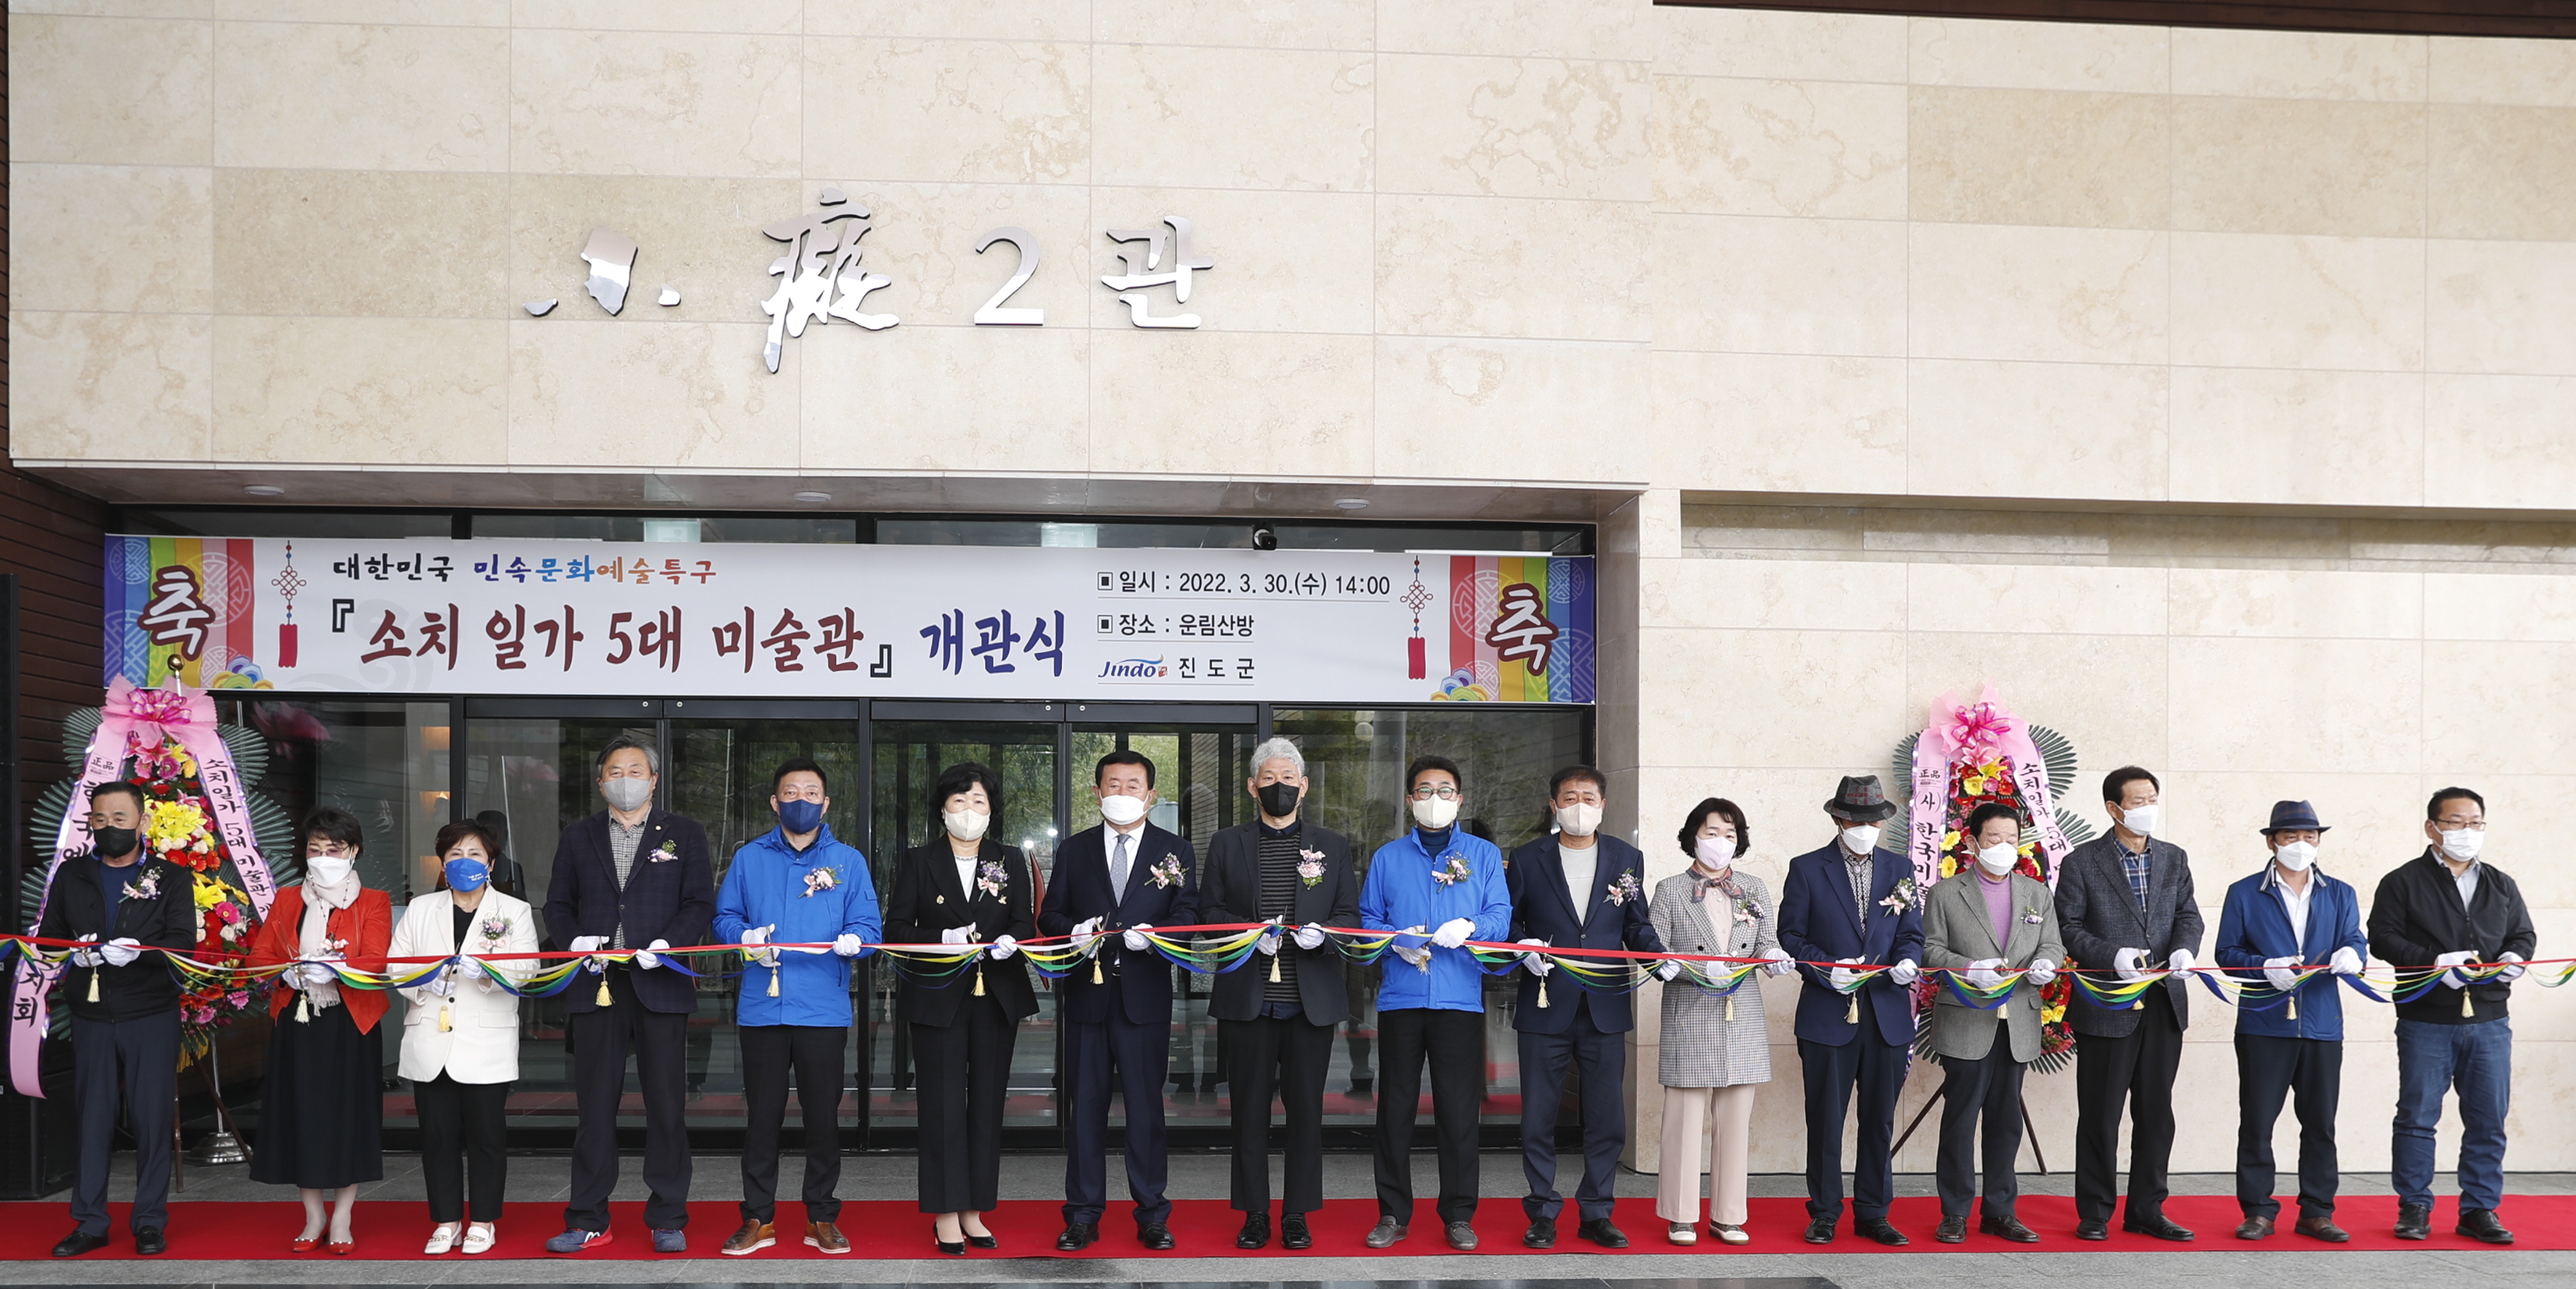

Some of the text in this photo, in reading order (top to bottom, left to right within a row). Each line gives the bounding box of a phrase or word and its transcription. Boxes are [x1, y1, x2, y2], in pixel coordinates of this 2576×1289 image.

[333, 553, 717, 584] 대한민국 민속문화예술특구
[1118, 570, 1156, 593] 일시
[1179, 573, 1233, 593] 2022.
[1240, 574, 1257, 593] 3.
[1264, 572, 1327, 596] 30.(수)
[1335, 575, 1391, 595] 14:00
[137, 564, 216, 662] 축
[1118, 613, 1156, 636] 장소
[1178, 613, 1254, 637] 운림산방
[485, 603, 584, 672] 일가
[605, 606, 682, 673] 5대
[919, 608, 1064, 676] 개관식
[1485, 582, 1559, 676] 축
[1097, 661, 1156, 678] Jindo
[90, 756, 115, 771] 正品
[1918, 768, 1941, 779] 正品
[1914, 790, 1942, 814] (사)
[224, 822, 247, 849] 5대
[235, 854, 270, 897] 미술관
